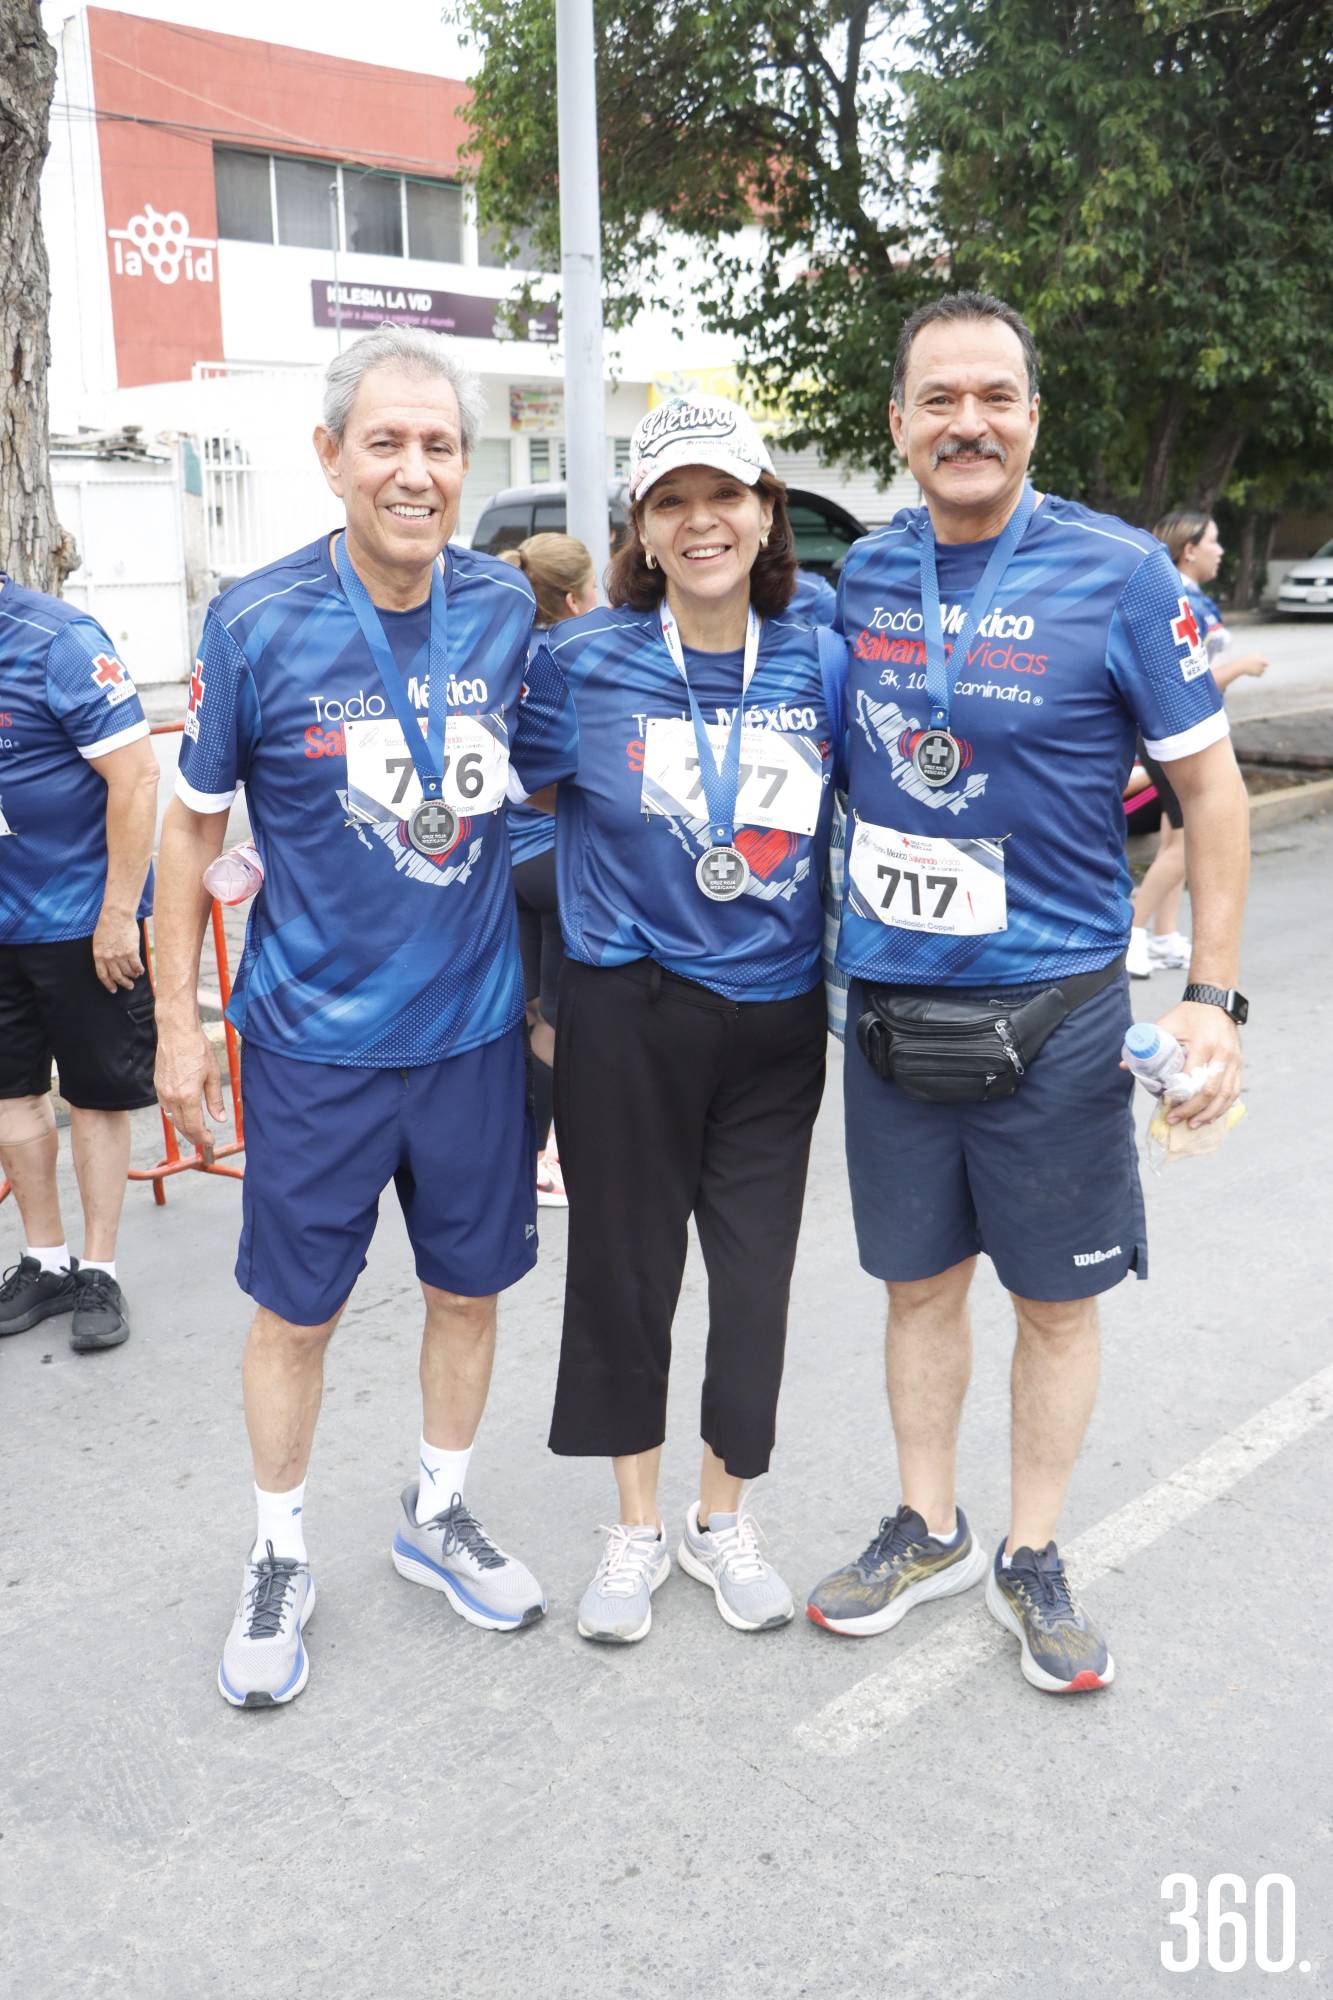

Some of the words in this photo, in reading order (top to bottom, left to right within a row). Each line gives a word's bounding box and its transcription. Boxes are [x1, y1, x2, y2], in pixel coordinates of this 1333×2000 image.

[386, 290, 407, 310] LA
[407, 293, 433, 312] VID
[867, 607, 923, 632] Todo
[879, 669, 901, 690] 5k,
[906, 672, 928, 690] 10
[309, 690, 385, 722] Todo
[385, 752, 484, 804] 76
[877, 864, 958, 918] 717
[1073, 1245, 1122, 1267] Wilson
